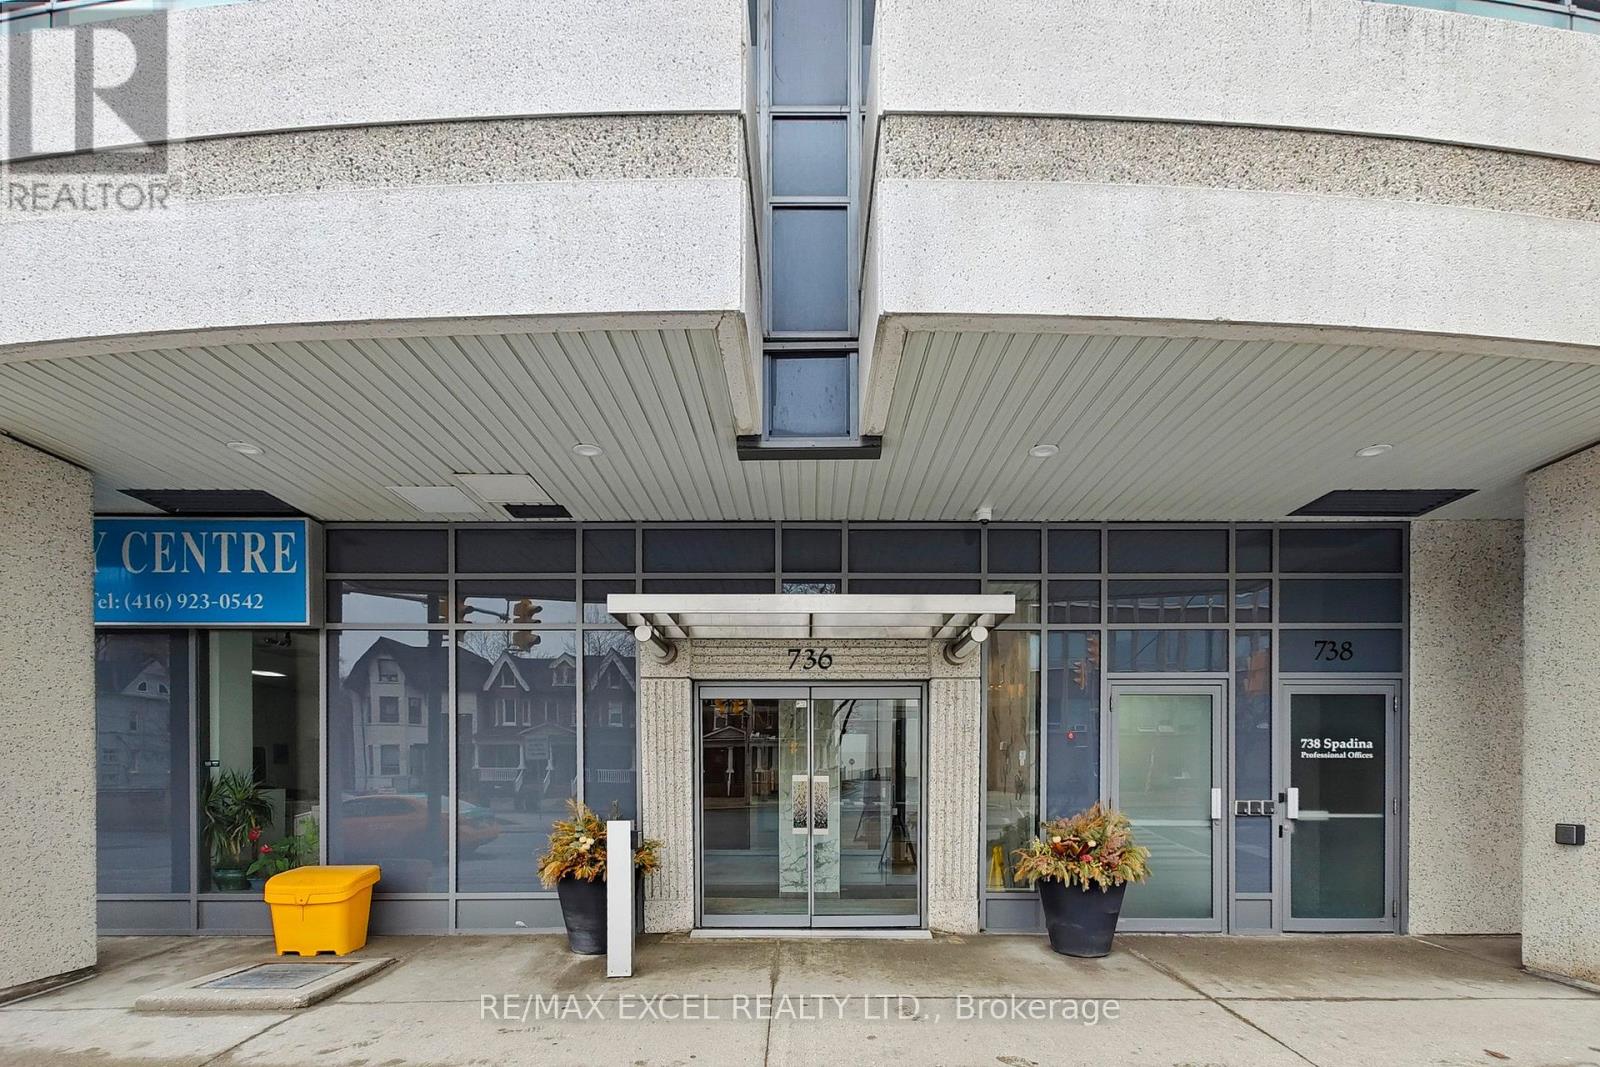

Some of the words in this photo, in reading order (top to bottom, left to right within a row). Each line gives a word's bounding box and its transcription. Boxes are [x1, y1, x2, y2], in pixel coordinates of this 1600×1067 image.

[121, 531, 298, 574] CENTRE
[95, 592, 120, 609] el:
[125, 592, 171, 612] (416)
[177, 593, 264, 609] 923-0542
[788, 648, 833, 670] 736
[1314, 640, 1353, 661] 738
[1301, 738, 1321, 749] 738
[1323, 738, 1373, 752] Spadina
[1301, 751, 1346, 759] Professional
[1347, 751, 1374, 759] Offices
